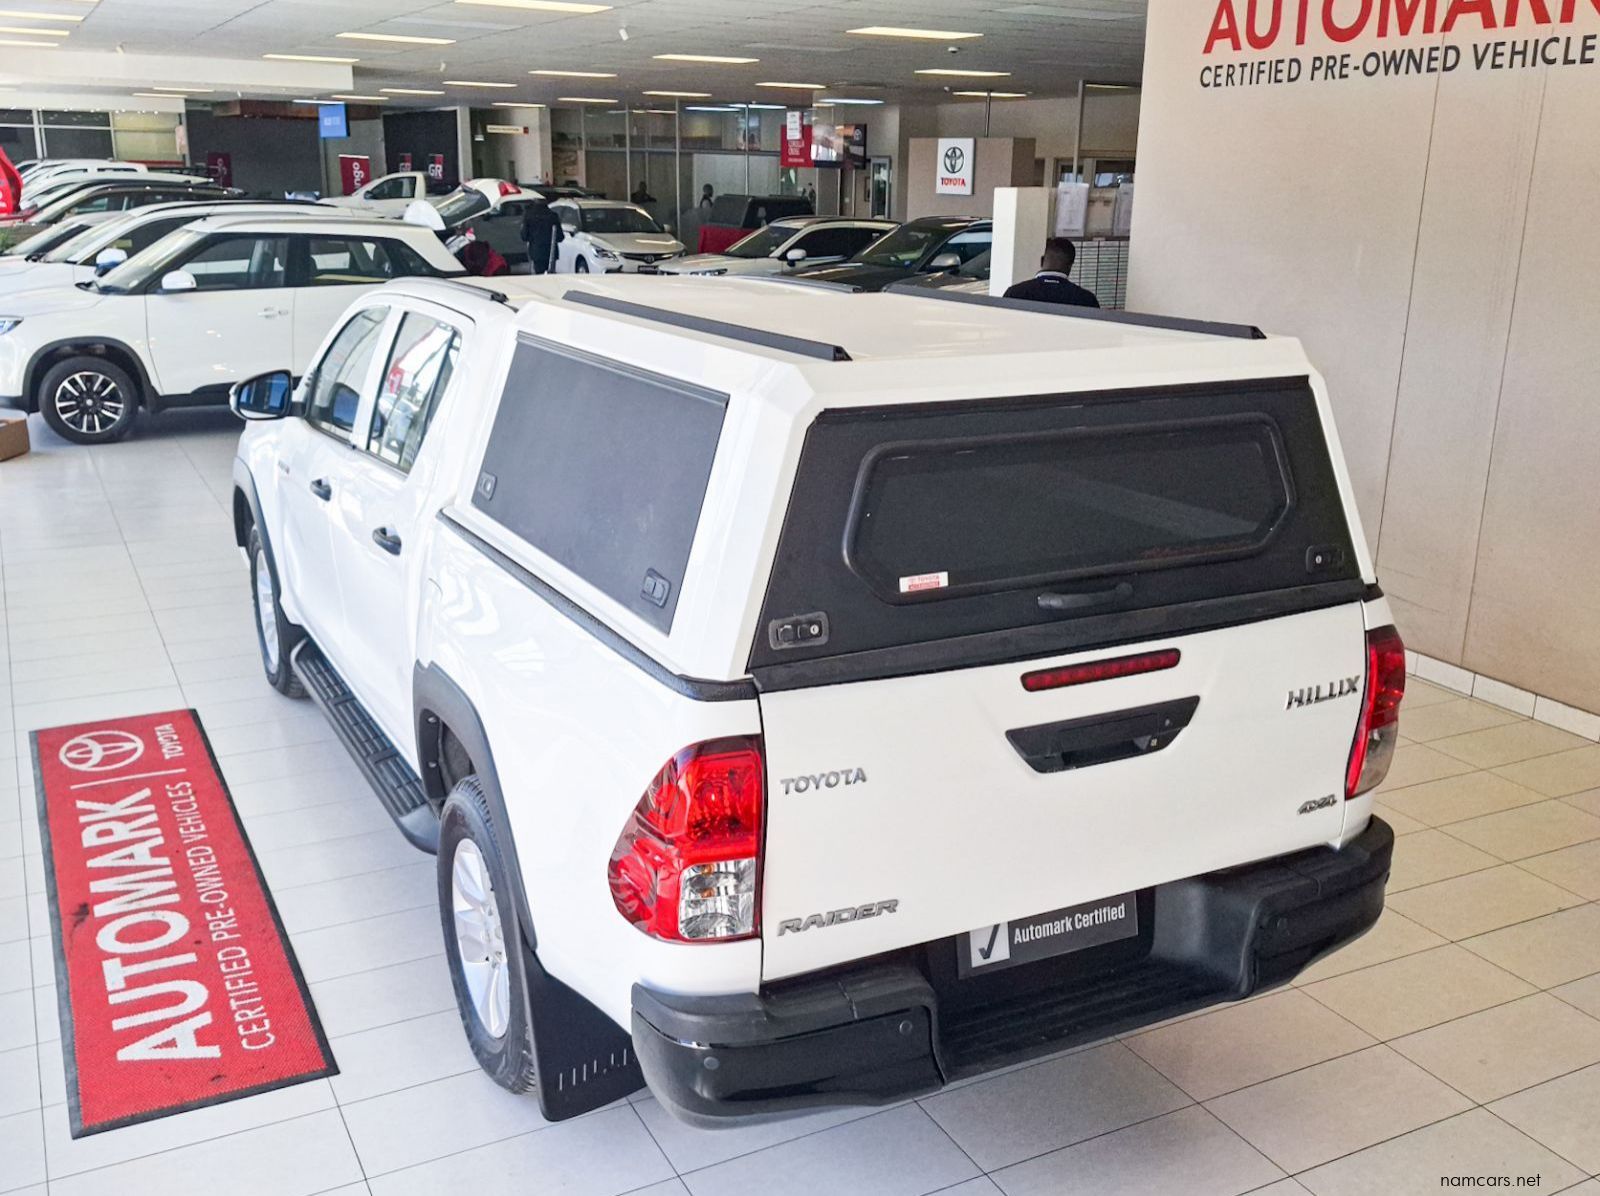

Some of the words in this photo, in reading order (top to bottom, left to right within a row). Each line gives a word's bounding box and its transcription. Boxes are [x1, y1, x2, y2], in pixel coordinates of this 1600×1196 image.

[1200, 57, 1301, 88] CERTIFIED
[1310, 44, 1461, 81] PRE-OWNED
[428, 163, 443, 177] GR
[940, 177, 966, 187] TOYOTA
[1285, 675, 1360, 711] HILUX
[780, 767, 867, 795] TOYOTA
[165, 781, 207, 844] VEHICLES
[186, 846, 242, 943] PRE-OWNED
[75, 787, 222, 1061] AUTOMARK
[777, 899, 899, 937] RAIDER
[1014, 916, 1073, 944] Automark
[1074, 902, 1126, 929] Certified
[216, 946, 276, 1050] CERTIFIED
